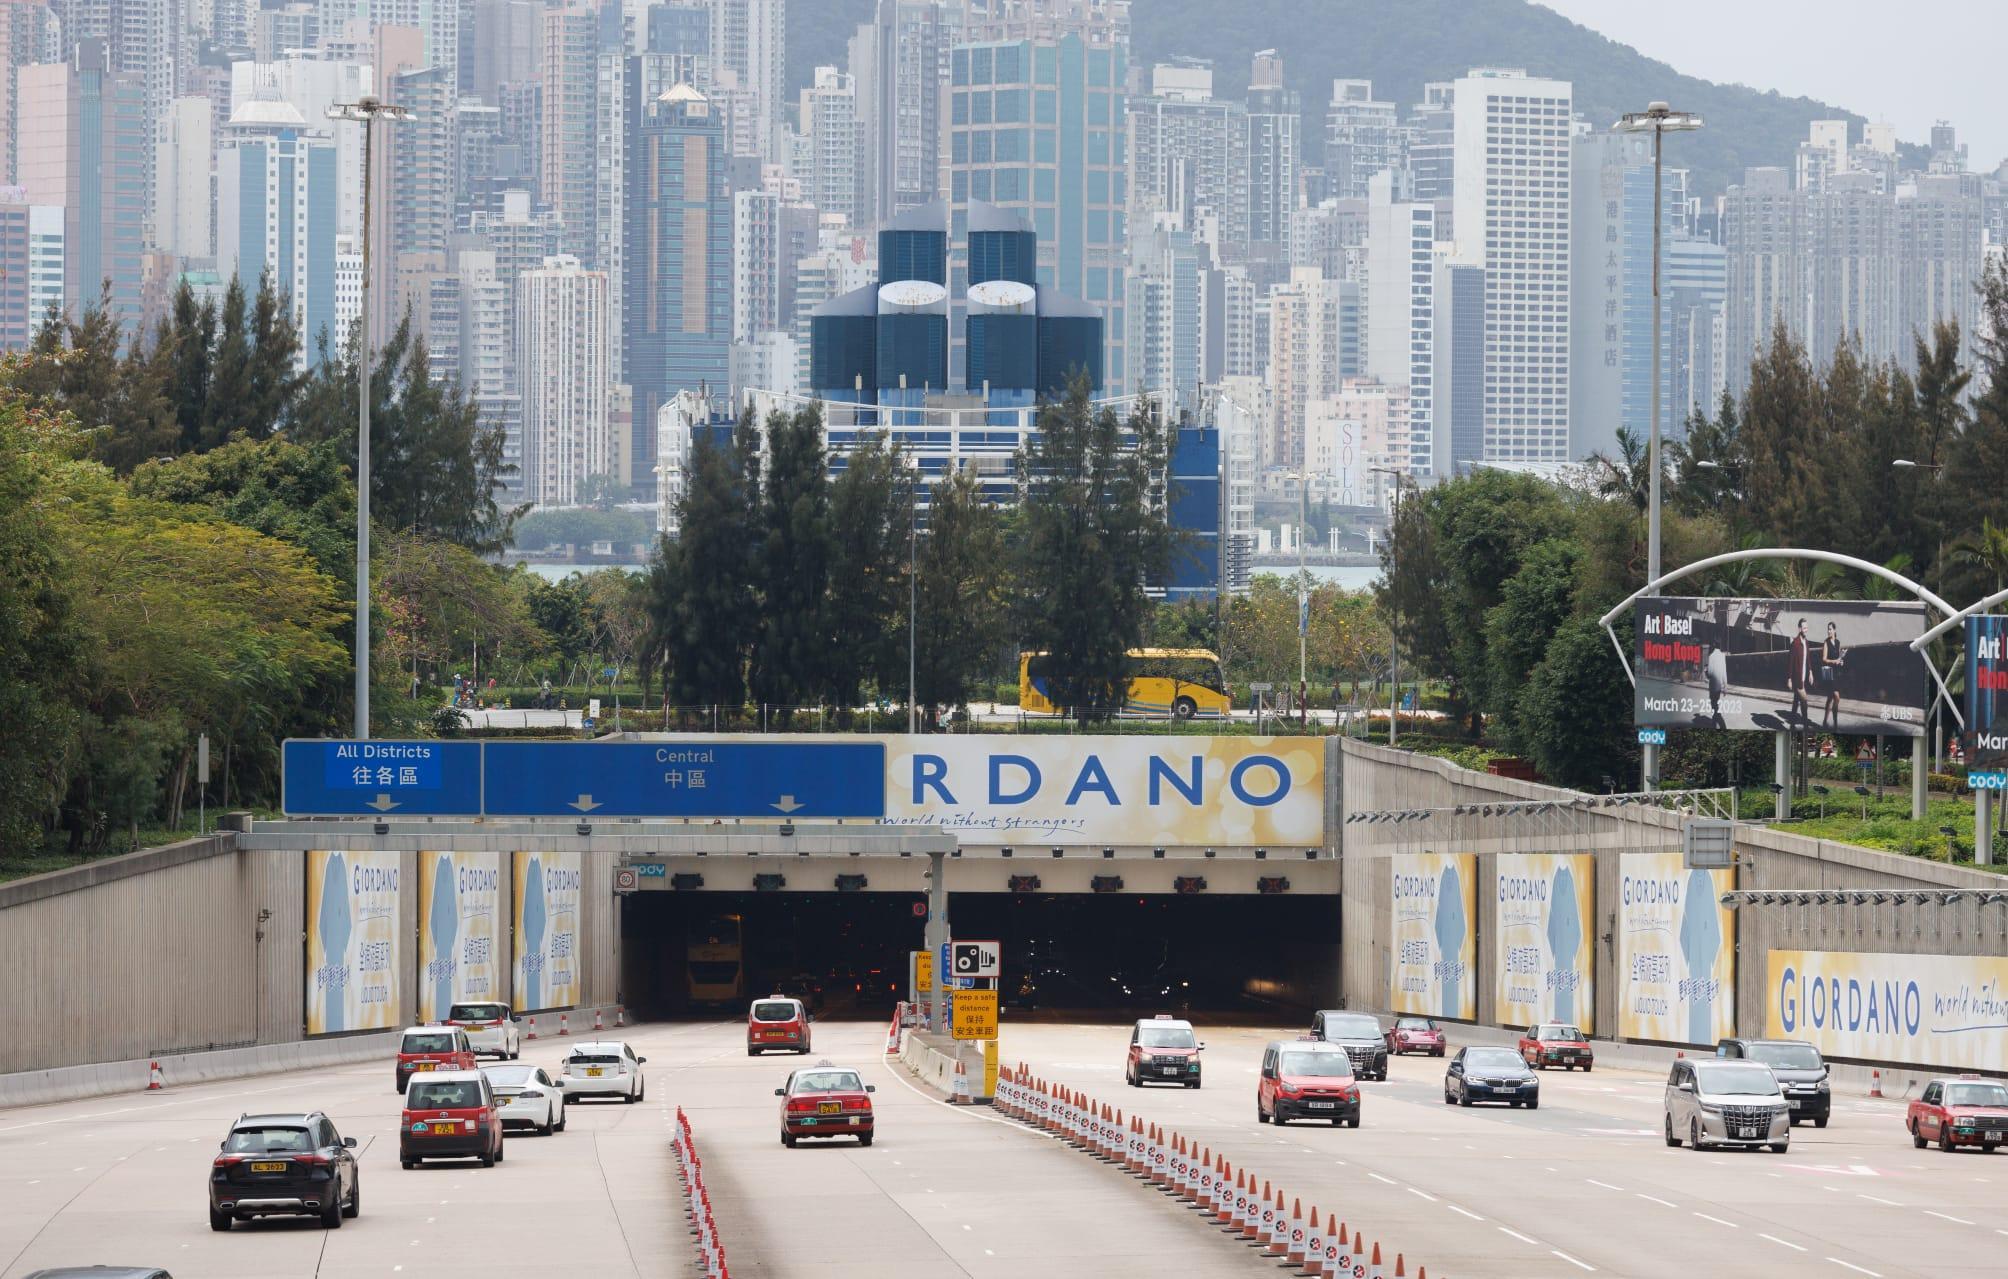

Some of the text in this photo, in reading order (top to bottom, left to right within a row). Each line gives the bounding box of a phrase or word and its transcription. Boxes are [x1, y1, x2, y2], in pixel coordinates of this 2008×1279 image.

[1604, 200, 1618, 367] 港島太平洋酒店
[1342, 423, 1353, 504] SOLO
[1644, 614, 1692, 635] Art Basel
[1644, 640, 1701, 665] Hong Kong
[1977, 636, 2001, 659] Art
[1644, 697, 1678, 712] March
[1717, 699, 1742, 713] 2023
[1892, 707, 1913, 721] UBS
[1638, 730, 1665, 744] cody
[336, 744, 431, 759] All Districts
[656, 748, 714, 763] Central
[352, 766, 418, 785] 往各區
[665, 769, 706, 789] 中區
[1969, 774, 2007, 789] cody
[353, 864, 398, 894] GIORDANO
[459, 866, 497, 894] GIORDANO
[546, 867, 579, 893] GIORDANO
[637, 865, 665, 875] ody
[1394, 873, 1435, 899] GIORDANO
[1499, 875, 1546, 902] GIORDANO
[1623, 876, 1679, 906] GIORDANO
[1780, 967, 1920, 1037] GIORDANO
[956, 1026, 994, 1036] 安全車距
